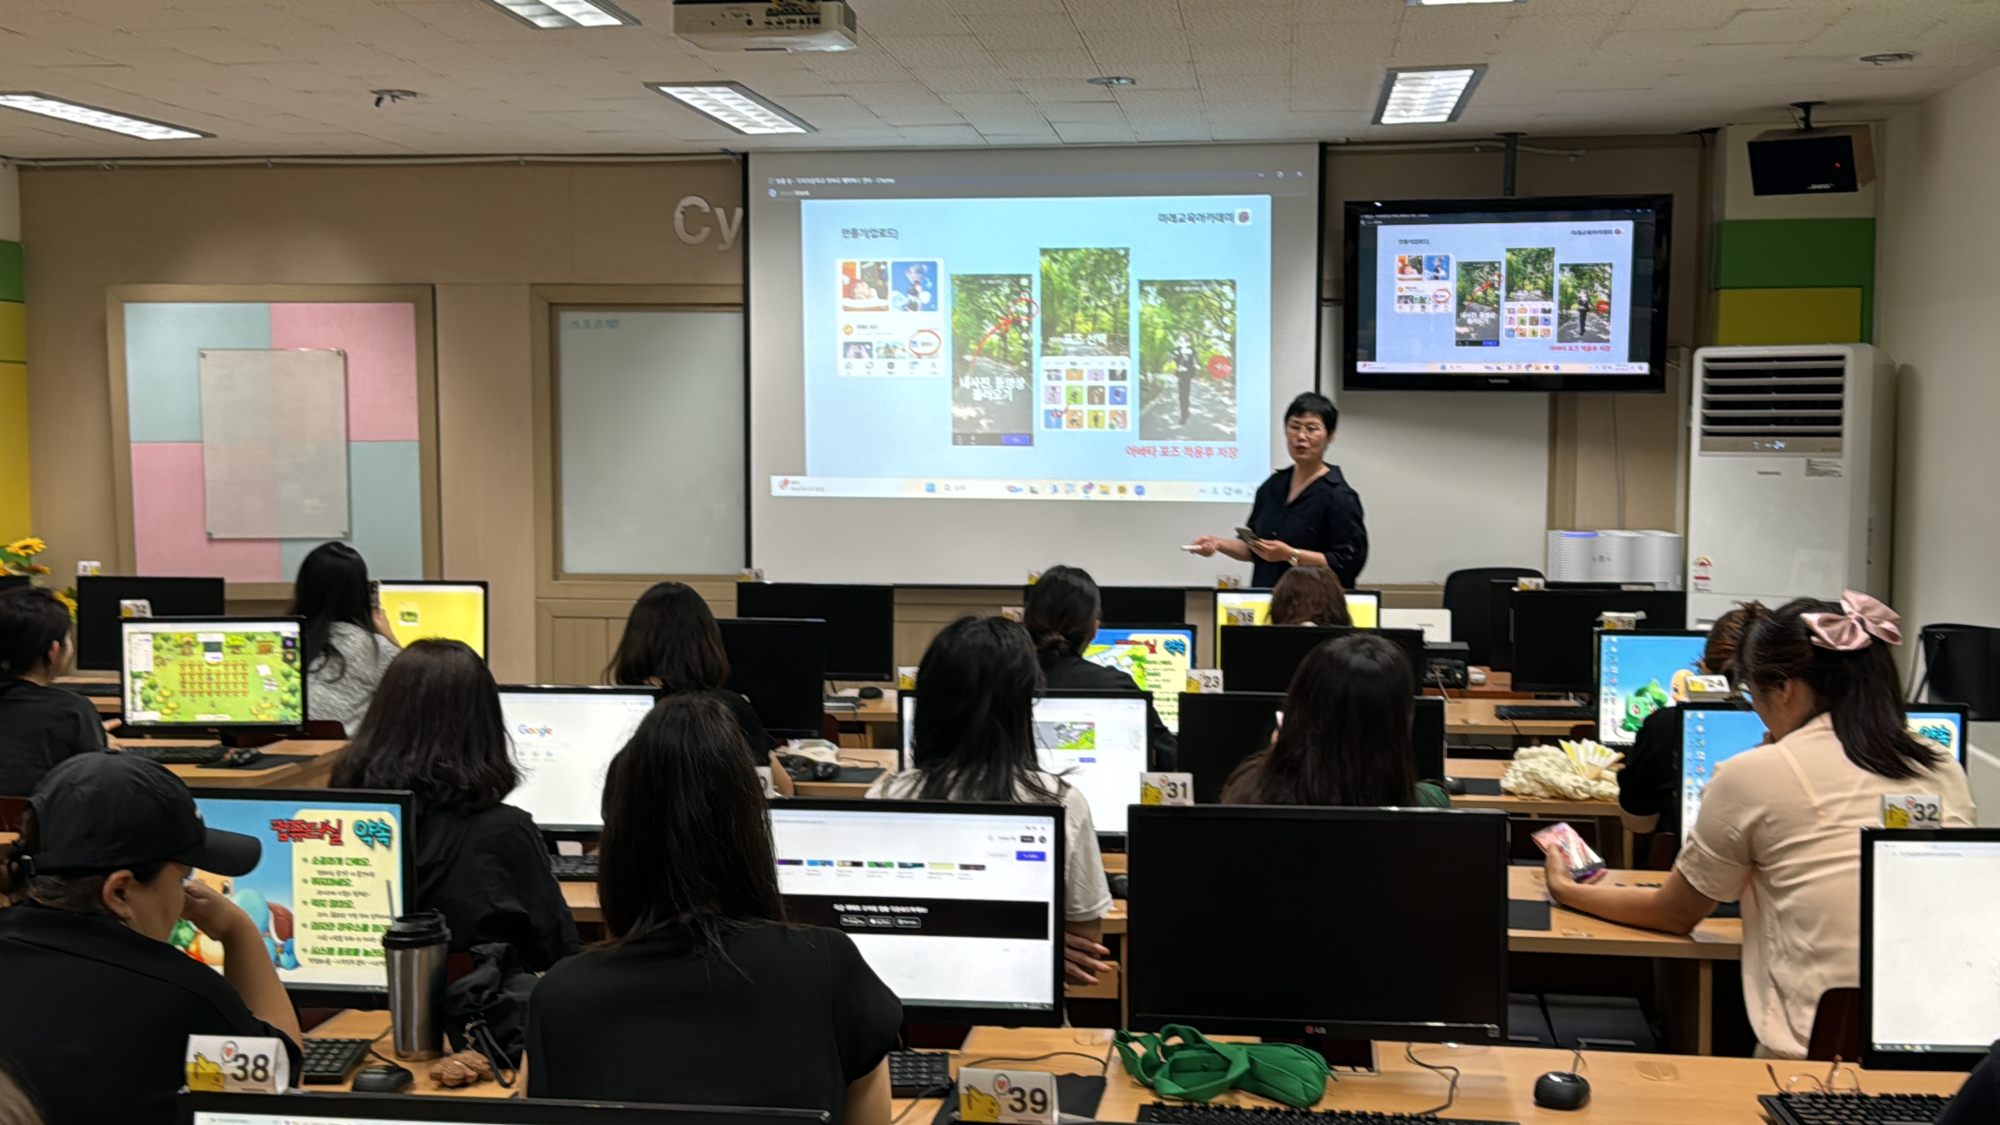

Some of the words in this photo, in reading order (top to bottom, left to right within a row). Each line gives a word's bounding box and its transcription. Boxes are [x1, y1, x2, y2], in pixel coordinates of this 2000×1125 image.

[673, 195, 744, 251] Cy
[1203, 675, 1220, 689] 23
[1707, 679, 1725, 689] 24
[518, 724, 553, 738] Google
[1167, 781, 1188, 800] 31
[1912, 803, 1940, 822] 32
[269, 818, 345, 847] 컴퓨터실
[352, 817, 392, 851] 약속
[231, 1053, 270, 1083] 38
[1008, 1086, 1049, 1115] 39
